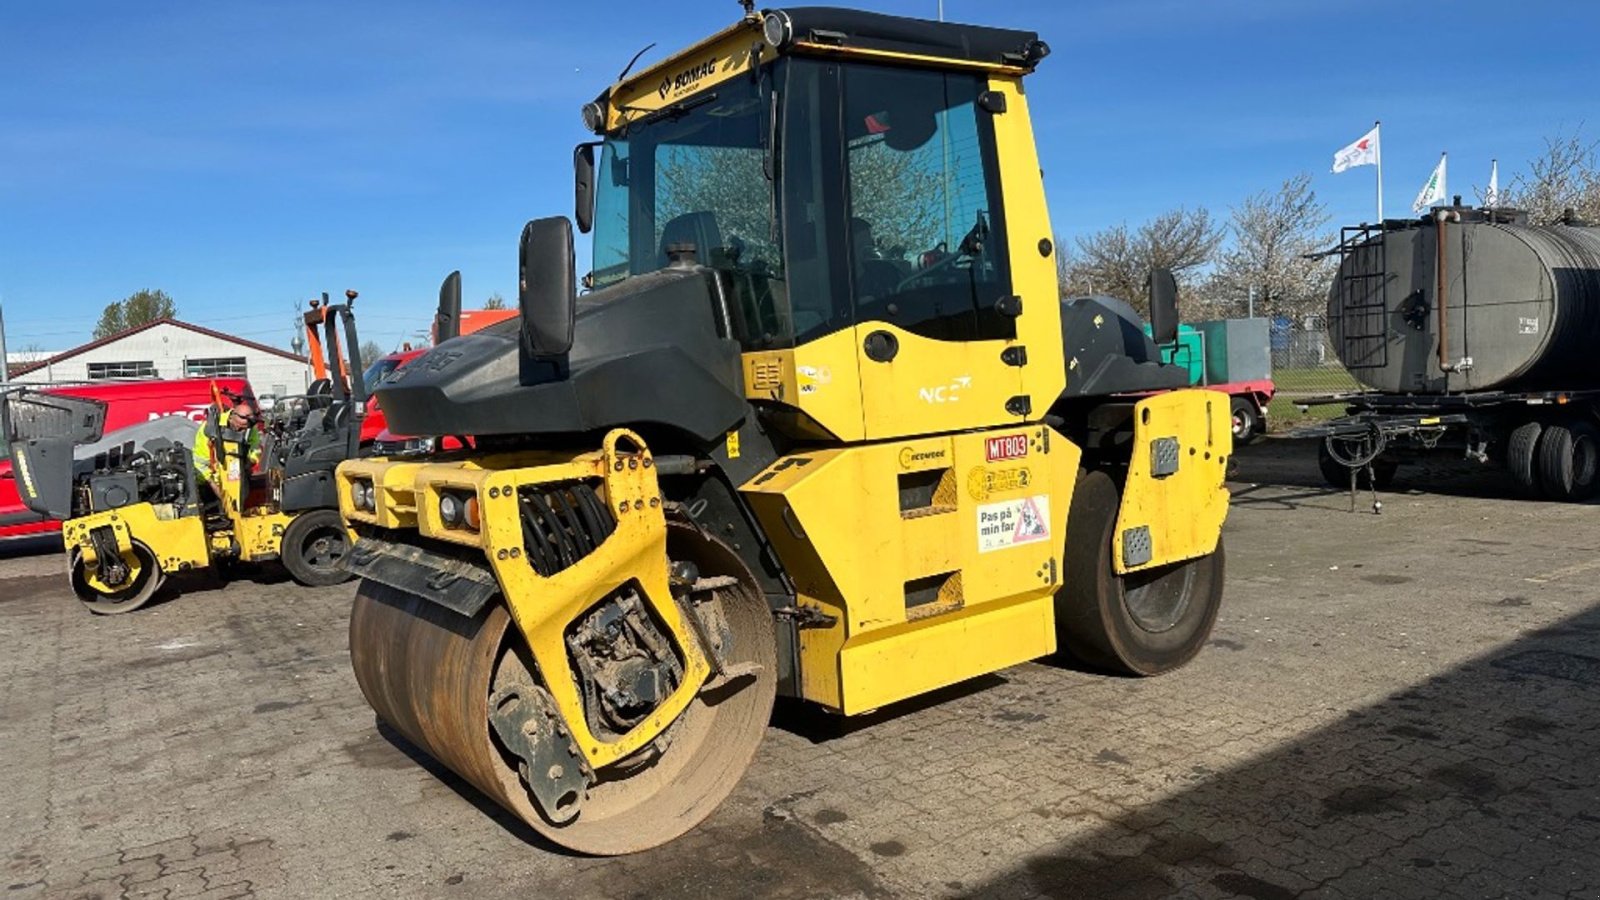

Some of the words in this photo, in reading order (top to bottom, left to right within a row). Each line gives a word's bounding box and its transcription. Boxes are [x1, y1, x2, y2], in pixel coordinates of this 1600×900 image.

[674, 57, 717, 90] BOMAG
[989, 436, 1026, 459] MT803
[981, 511, 998, 523] Pas
[1000, 507, 1012, 522] på
[981, 523, 1000, 536] min
[1001, 521, 1015, 533] far
